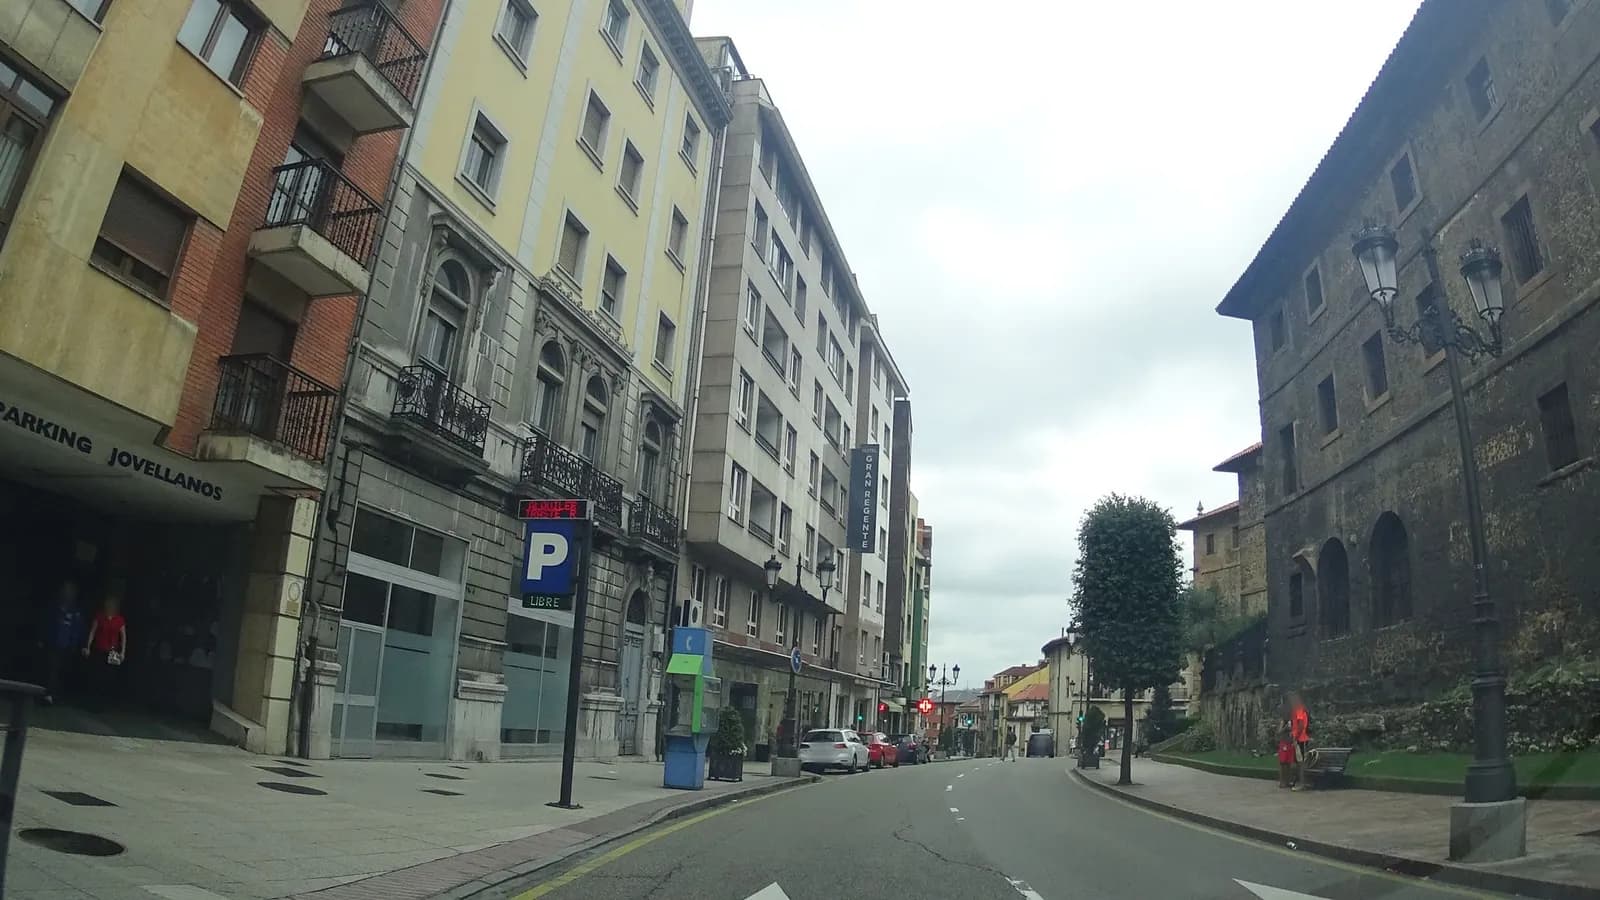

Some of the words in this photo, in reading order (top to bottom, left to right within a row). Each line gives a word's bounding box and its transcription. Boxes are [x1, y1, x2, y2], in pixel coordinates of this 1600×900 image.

[107, 447, 223, 501] JOVELLANOS
[865, 455, 873, 487] GRAN
[862, 490, 871, 548] REGENTE
[527, 532, 568, 580] P
[530, 595, 560, 608] LIBRE
